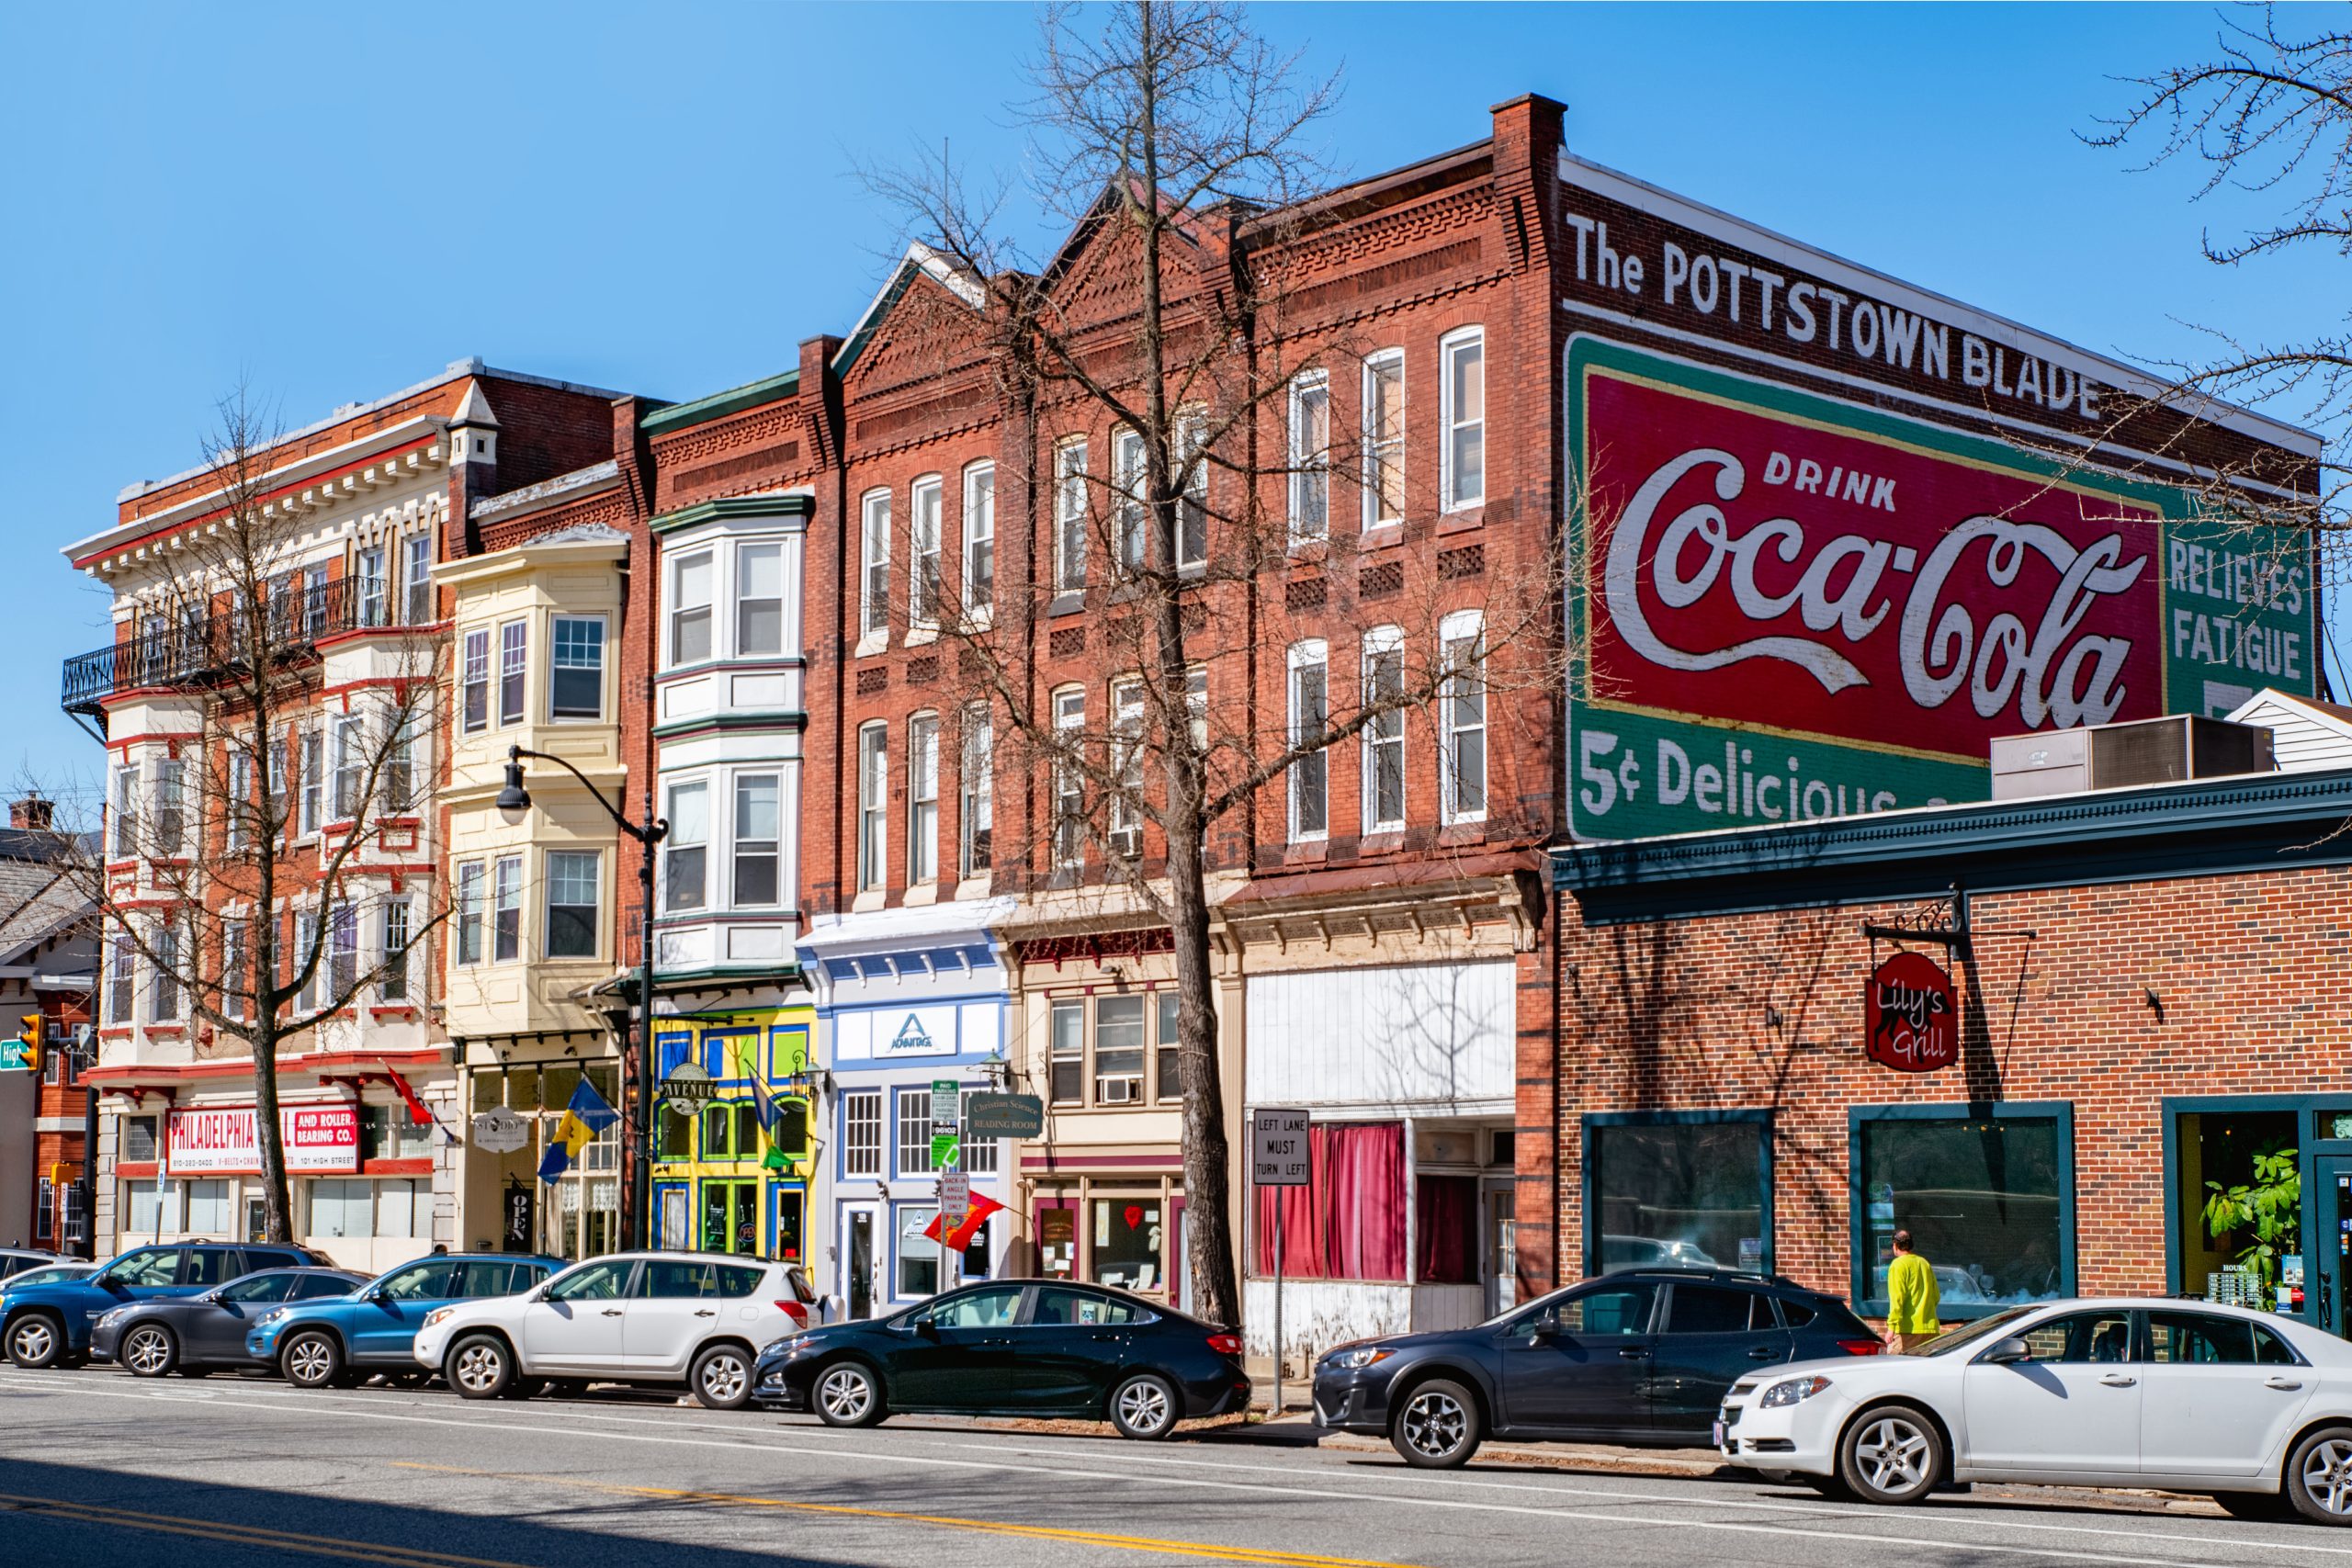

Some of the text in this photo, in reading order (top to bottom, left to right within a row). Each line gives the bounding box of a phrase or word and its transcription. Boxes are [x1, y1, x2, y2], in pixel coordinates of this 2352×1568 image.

[1566, 213, 2100, 421] The POTTSTOWN BLADE
[1762, 451, 1897, 512] DRINK
[2170, 539, 2304, 615] RELIEVES
[1605, 447, 2148, 729] Coca-Cola
[2174, 608, 2301, 680] FATIGUE
[1579, 729, 1641, 817] 5¢
[1876, 978, 1944, 1029] Lily's
[891, 1036, 933, 1049] ADVANTAGE
[1893, 1024, 1947, 1065] Grill
[3, 1044, 22, 1066] High
[664, 1083, 714, 1097] AVENUE
[974, 1099, 1038, 1115] Christian Science
[298, 1114, 317, 1127] AND
[974, 1120, 1037, 1130] READING ROOM
[1259, 1119, 1306, 1131] LEFT LANE
[172, 1112, 254, 1150] PHILADELPHIA
[297, 1129, 353, 1144] BEARING CO.
[1267, 1140, 1295, 1154] MUST
[313, 1156, 328, 1165] HIGH
[331, 1156, 354, 1164] STREET
[1257, 1163, 1306, 1176] TURN LEFT
[512, 1195, 527, 1240] OPEN
[2222, 1264, 2248, 1272] HOURS
